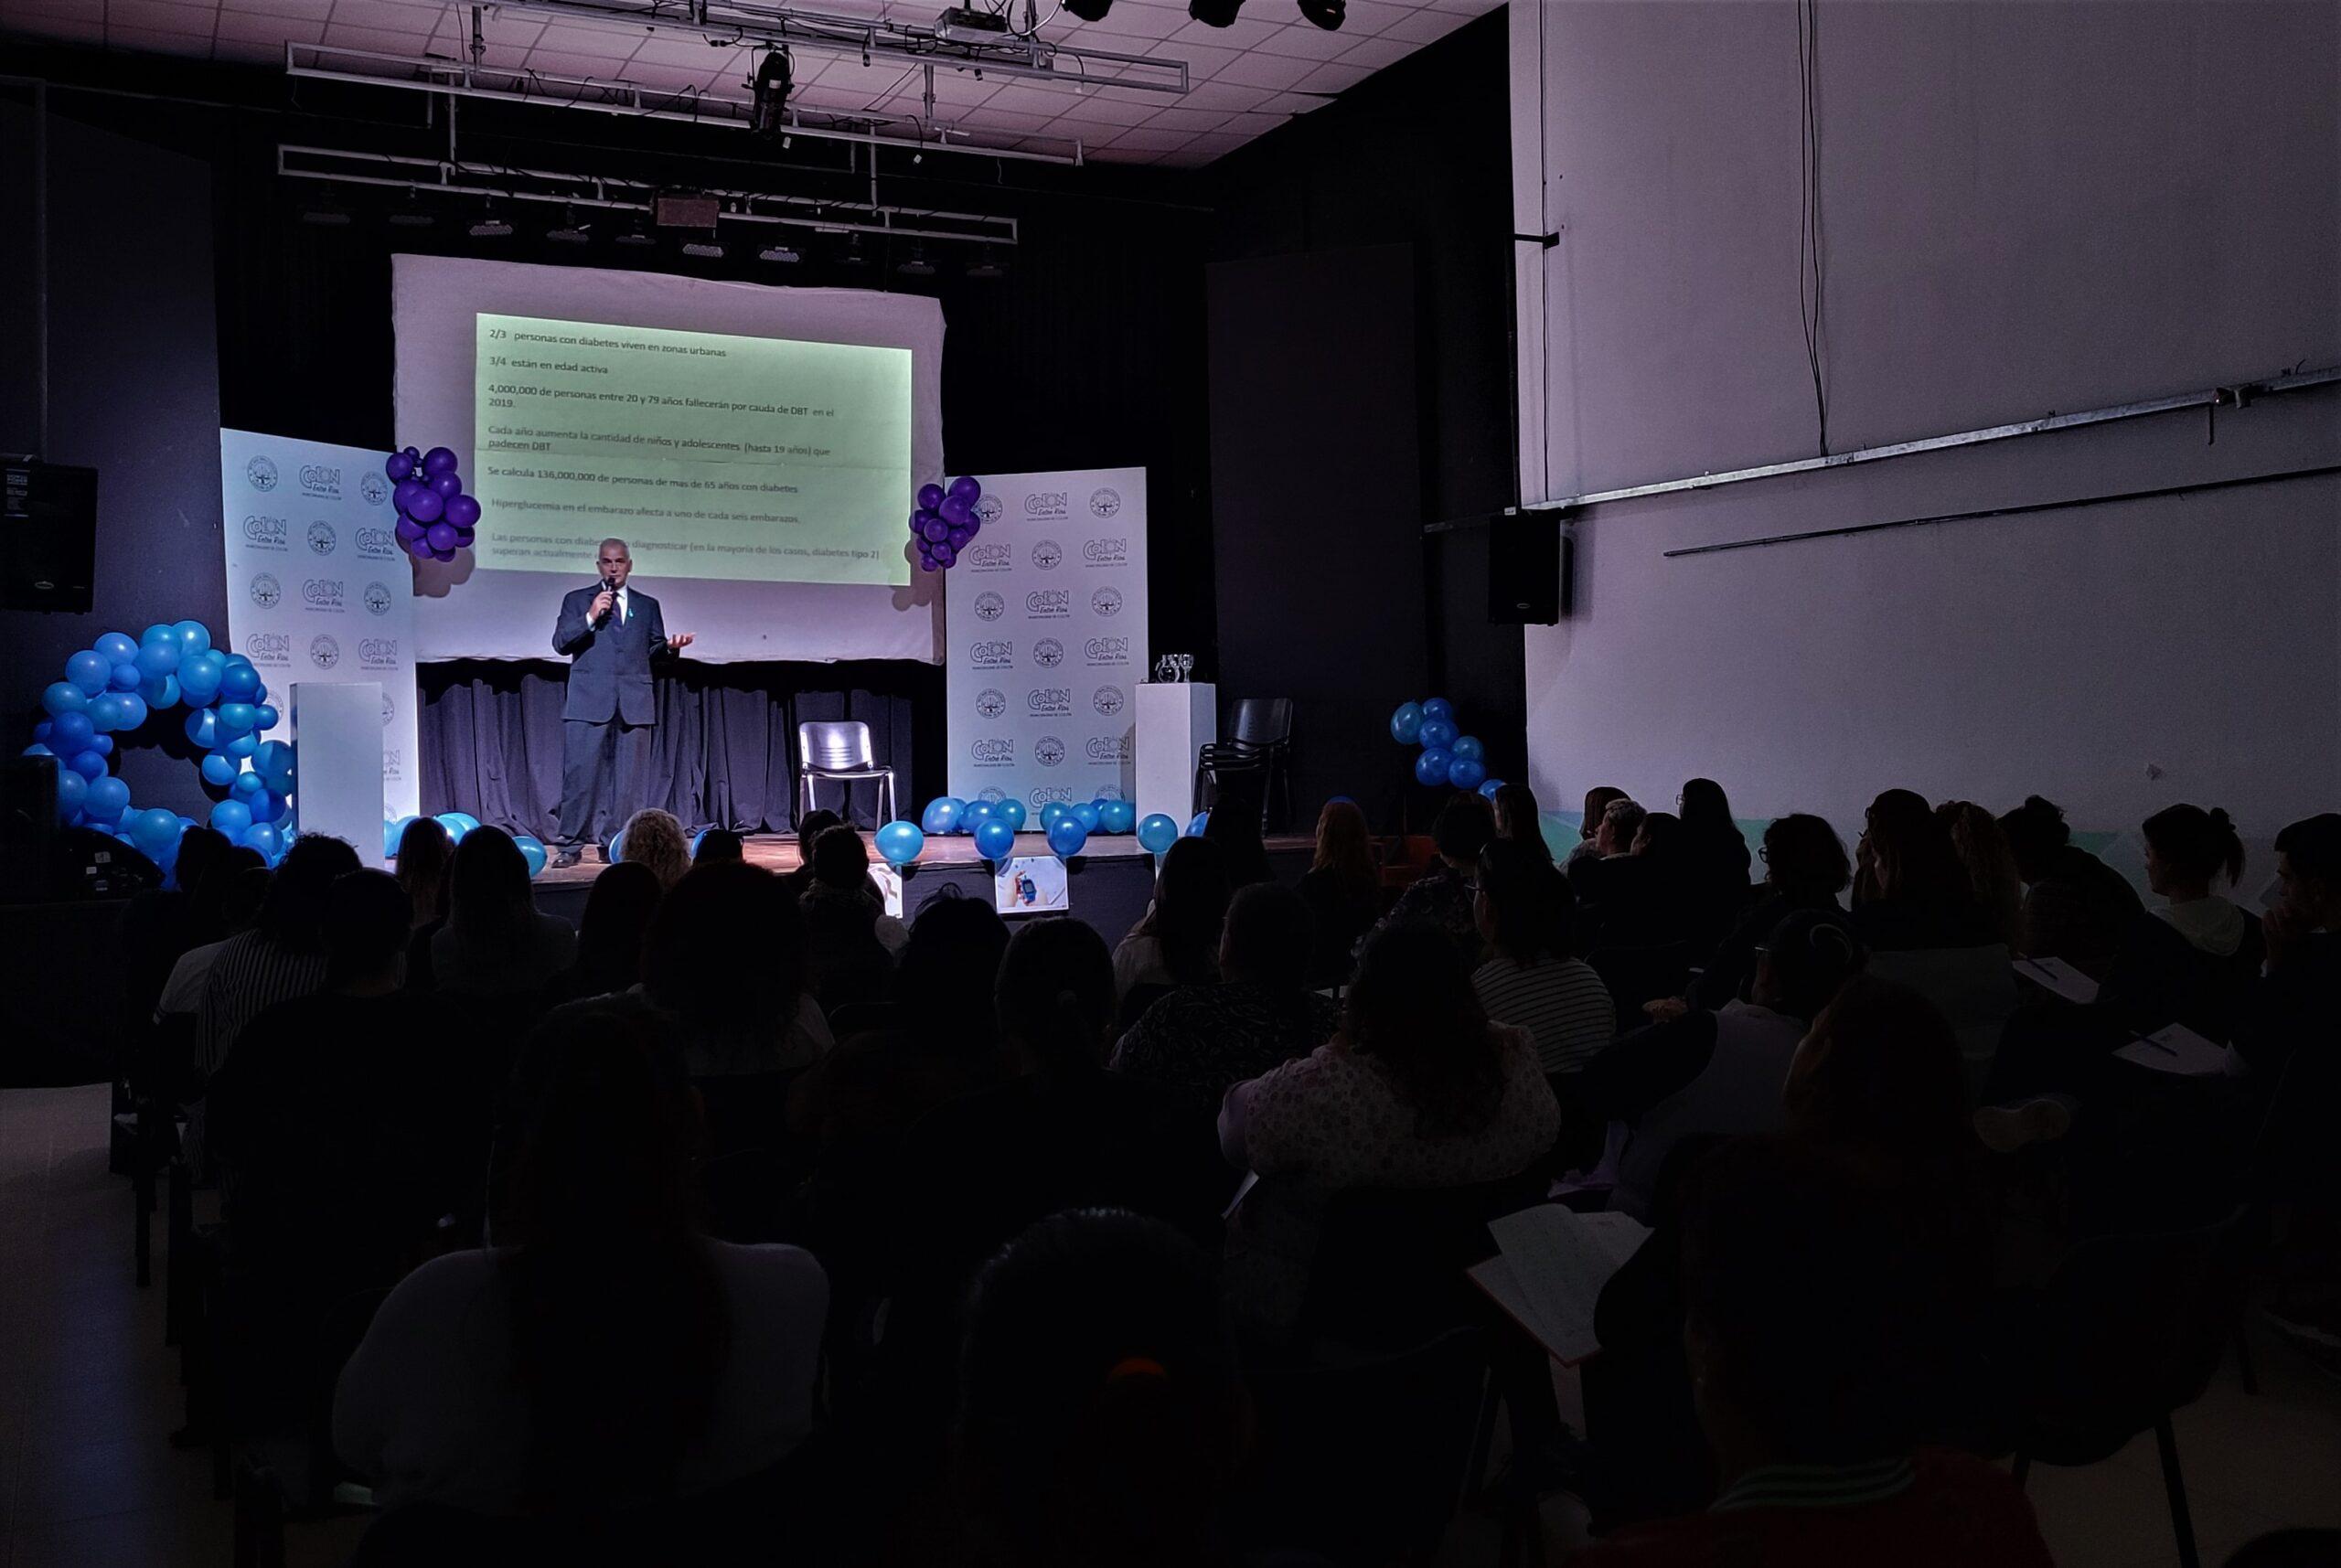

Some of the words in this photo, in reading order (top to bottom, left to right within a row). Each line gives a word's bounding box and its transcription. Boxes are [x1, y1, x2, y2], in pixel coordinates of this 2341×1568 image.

[489, 329, 507, 339] 2/3
[514, 332, 558, 344] personas
[560, 336, 577, 345] con
[579, 337, 619, 348] diabetes
[621, 341, 646, 350] viven
[662, 346, 688, 354] zonas
[689, 347, 726, 357] urbanas
[490, 357, 506, 367] 3/4
[511, 358, 538, 369] están
[540, 362, 552, 370] en
[554, 362, 578, 372] edad
[580, 364, 608, 374] activa
[488, 384, 537, 396] 4,000,000
[540, 388, 551, 397] de
[554, 389, 596, 400] personas
[599, 393, 624, 402] entre
[625, 394, 638, 403] 20
[647, 395, 659, 404] 79
[661, 397, 684, 406] años
[686, 397, 730, 410] fallecerán
[732, 402, 746, 411] por
[748, 402, 775, 413] cauda
[777, 406, 788, 414] de
[790, 406, 808, 416] DBT
[826, 409, 834, 417] el
[488, 426, 512, 435] Cada
[515, 426, 533, 436] año
[536, 430, 578, 439] aumenta
[580, 432, 589, 440] la
[591, 432, 631, 444] cantidad
[633, 435, 646, 444] de
[647, 435, 671, 446] niños
[682, 437, 741, 451] adolescentes
[744, 443, 772, 453] (hasta
[775, 444, 785, 453] 19
[786, 445, 812, 456] años)
[813, 448, 830, 457] que
[488, 439, 530, 451] padecen
[532, 441, 551, 452] DBT
[488, 466, 499, 475] Se
[501, 468, 534, 478] calcula
[538, 470, 595, 482] 136,000,000
[597, 474, 609, 483] de
[611, 475, 654, 486] personas
[655, 477, 668, 486] de
[690, 480, 702, 488] de
[705, 481, 716, 490] 65
[718, 481, 740, 491] años
[760, 483, 798, 494] diabetes
[492, 498, 561, 512] Hiperglucemia
[576, 503, 585, 513] el
[587, 506, 635, 516] embarazo
[636, 507, 664, 517] afecta
[674, 510, 692, 518] uno
[694, 510, 706, 519] de
[708, 510, 730, 521] cada
[732, 513, 748, 521] seis
[574, 538, 600, 547] diabe
